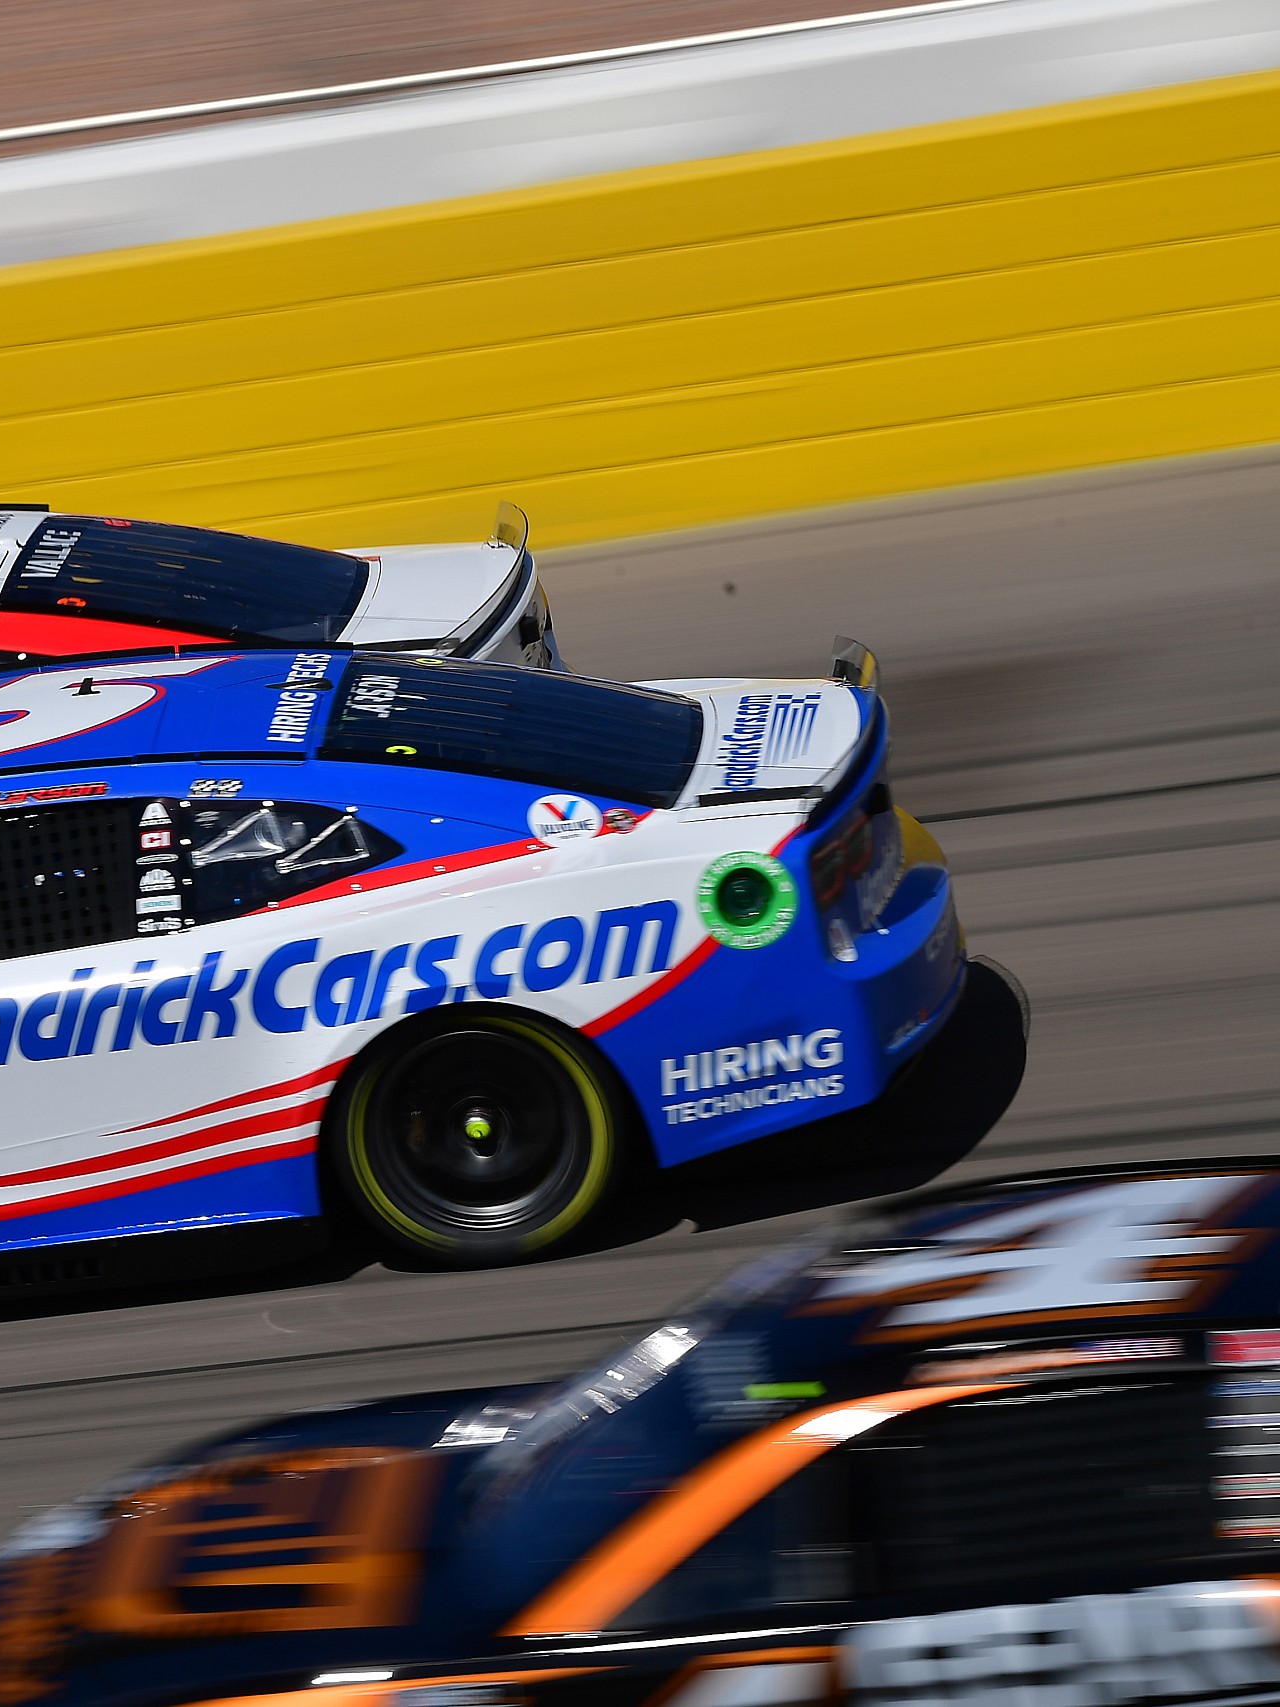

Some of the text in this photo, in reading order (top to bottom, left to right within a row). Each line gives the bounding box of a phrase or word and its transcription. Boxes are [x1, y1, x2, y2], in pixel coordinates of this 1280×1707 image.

[266, 653, 332, 743] HIRING TECHS
[660, 1028, 845, 1097] HIRING
[662, 1074, 845, 1135] TECHNICIANS
